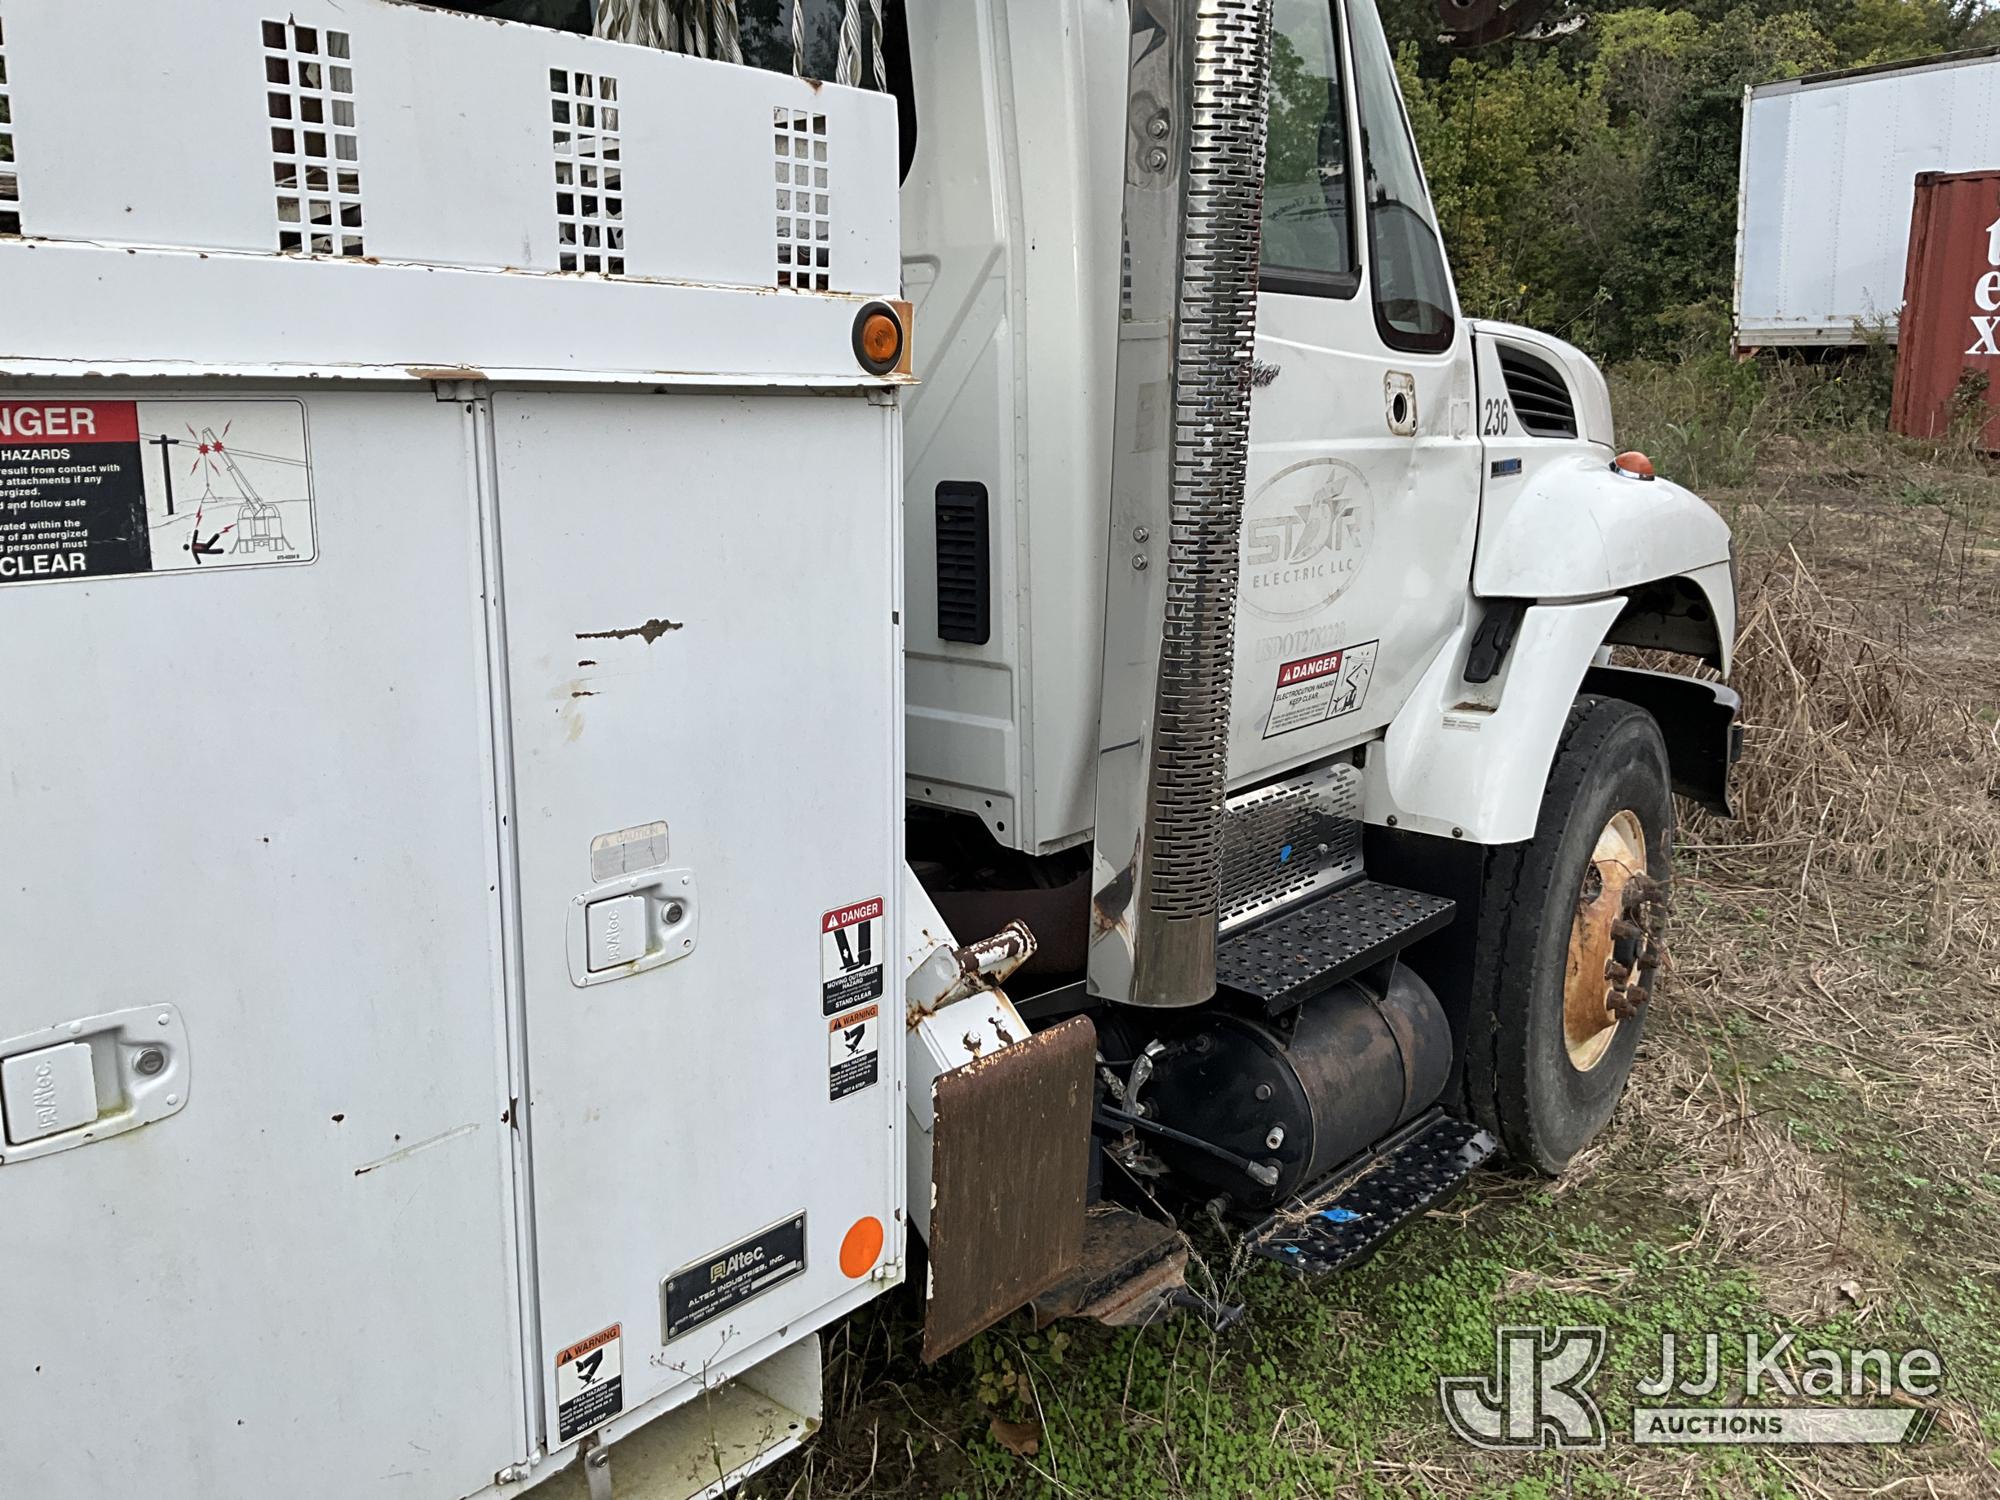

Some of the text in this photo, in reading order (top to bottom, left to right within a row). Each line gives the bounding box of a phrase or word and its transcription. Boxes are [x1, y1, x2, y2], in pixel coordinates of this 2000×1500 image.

[1484, 398, 1508, 436] 236
[1, 449, 71, 461] HAZARDS
[0, 463, 120, 475] esult from contact with
[7, 476, 71, 486] attachments
[74, 475, 82, 484] if
[84, 476, 102, 485] any
[7, 500, 27, 510] and
[30, 499, 62, 509] follow
[65, 498, 87, 508] safe
[29, 520, 61, 530] within
[64, 519, 81, 528] the
[8, 533, 19, 542] of
[22, 533, 35, 541] an
[38, 529, 89, 539] energized
[7, 541, 59, 554] personnel
[62, 540, 88, 549] must
[0, 552, 87, 576] CLEAR
[1253, 557, 1354, 589] ELECTRIC LLC
[1291, 656, 1338, 680] DANGER
[841, 903, 879, 924] DANGER
[835, 996, 854, 1009] STAND
[853, 990, 872, 1002] CLEAR
[843, 1007, 876, 1026] WARNING
[726, 1246, 763, 1276] Altec
[688, 1289, 716, 1308] ALTEC
[769, 1254, 786, 1267] INC.
[574, 1328, 617, 1355] WARNING
